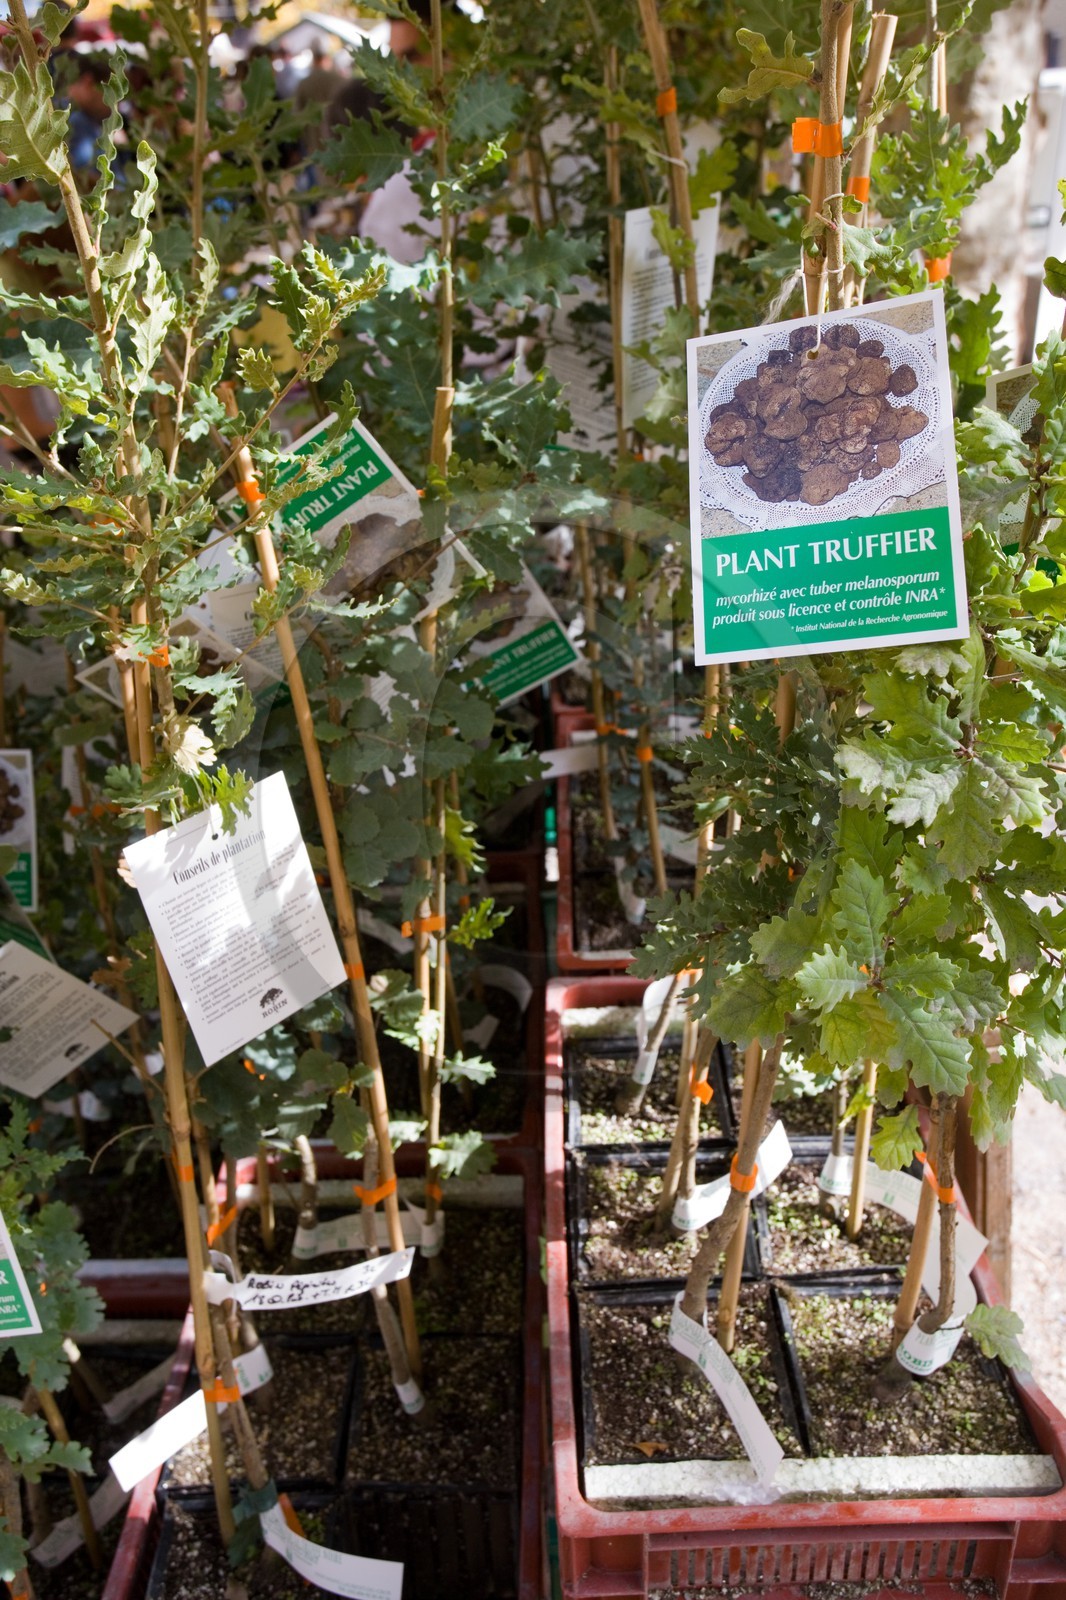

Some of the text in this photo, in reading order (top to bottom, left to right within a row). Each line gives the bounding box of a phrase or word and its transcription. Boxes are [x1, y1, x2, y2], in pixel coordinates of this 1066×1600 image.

[328, 459, 379, 502] PLANT
[716, 527, 937, 577] PLANT TRUFFIER
[715, 571, 940, 608] mycorhizé avec tuber melanosporum
[712, 608, 757, 629] produit
[758, 608, 786, 621] sous
[788, 603, 831, 617] licence
[834, 599, 846, 612] et
[849, 591, 902, 611] contrôle
[795, 622, 818, 632] Institut
[819, 619, 847, 630] National
[848, 618, 857, 627] de
[858, 618, 864, 626] la
[865, 614, 901, 625] Recherche
[901, 609, 948, 622] Agronomique
[171, 829, 267, 885] Conseils de plantation
[261, 997, 288, 1018] ROBIN
